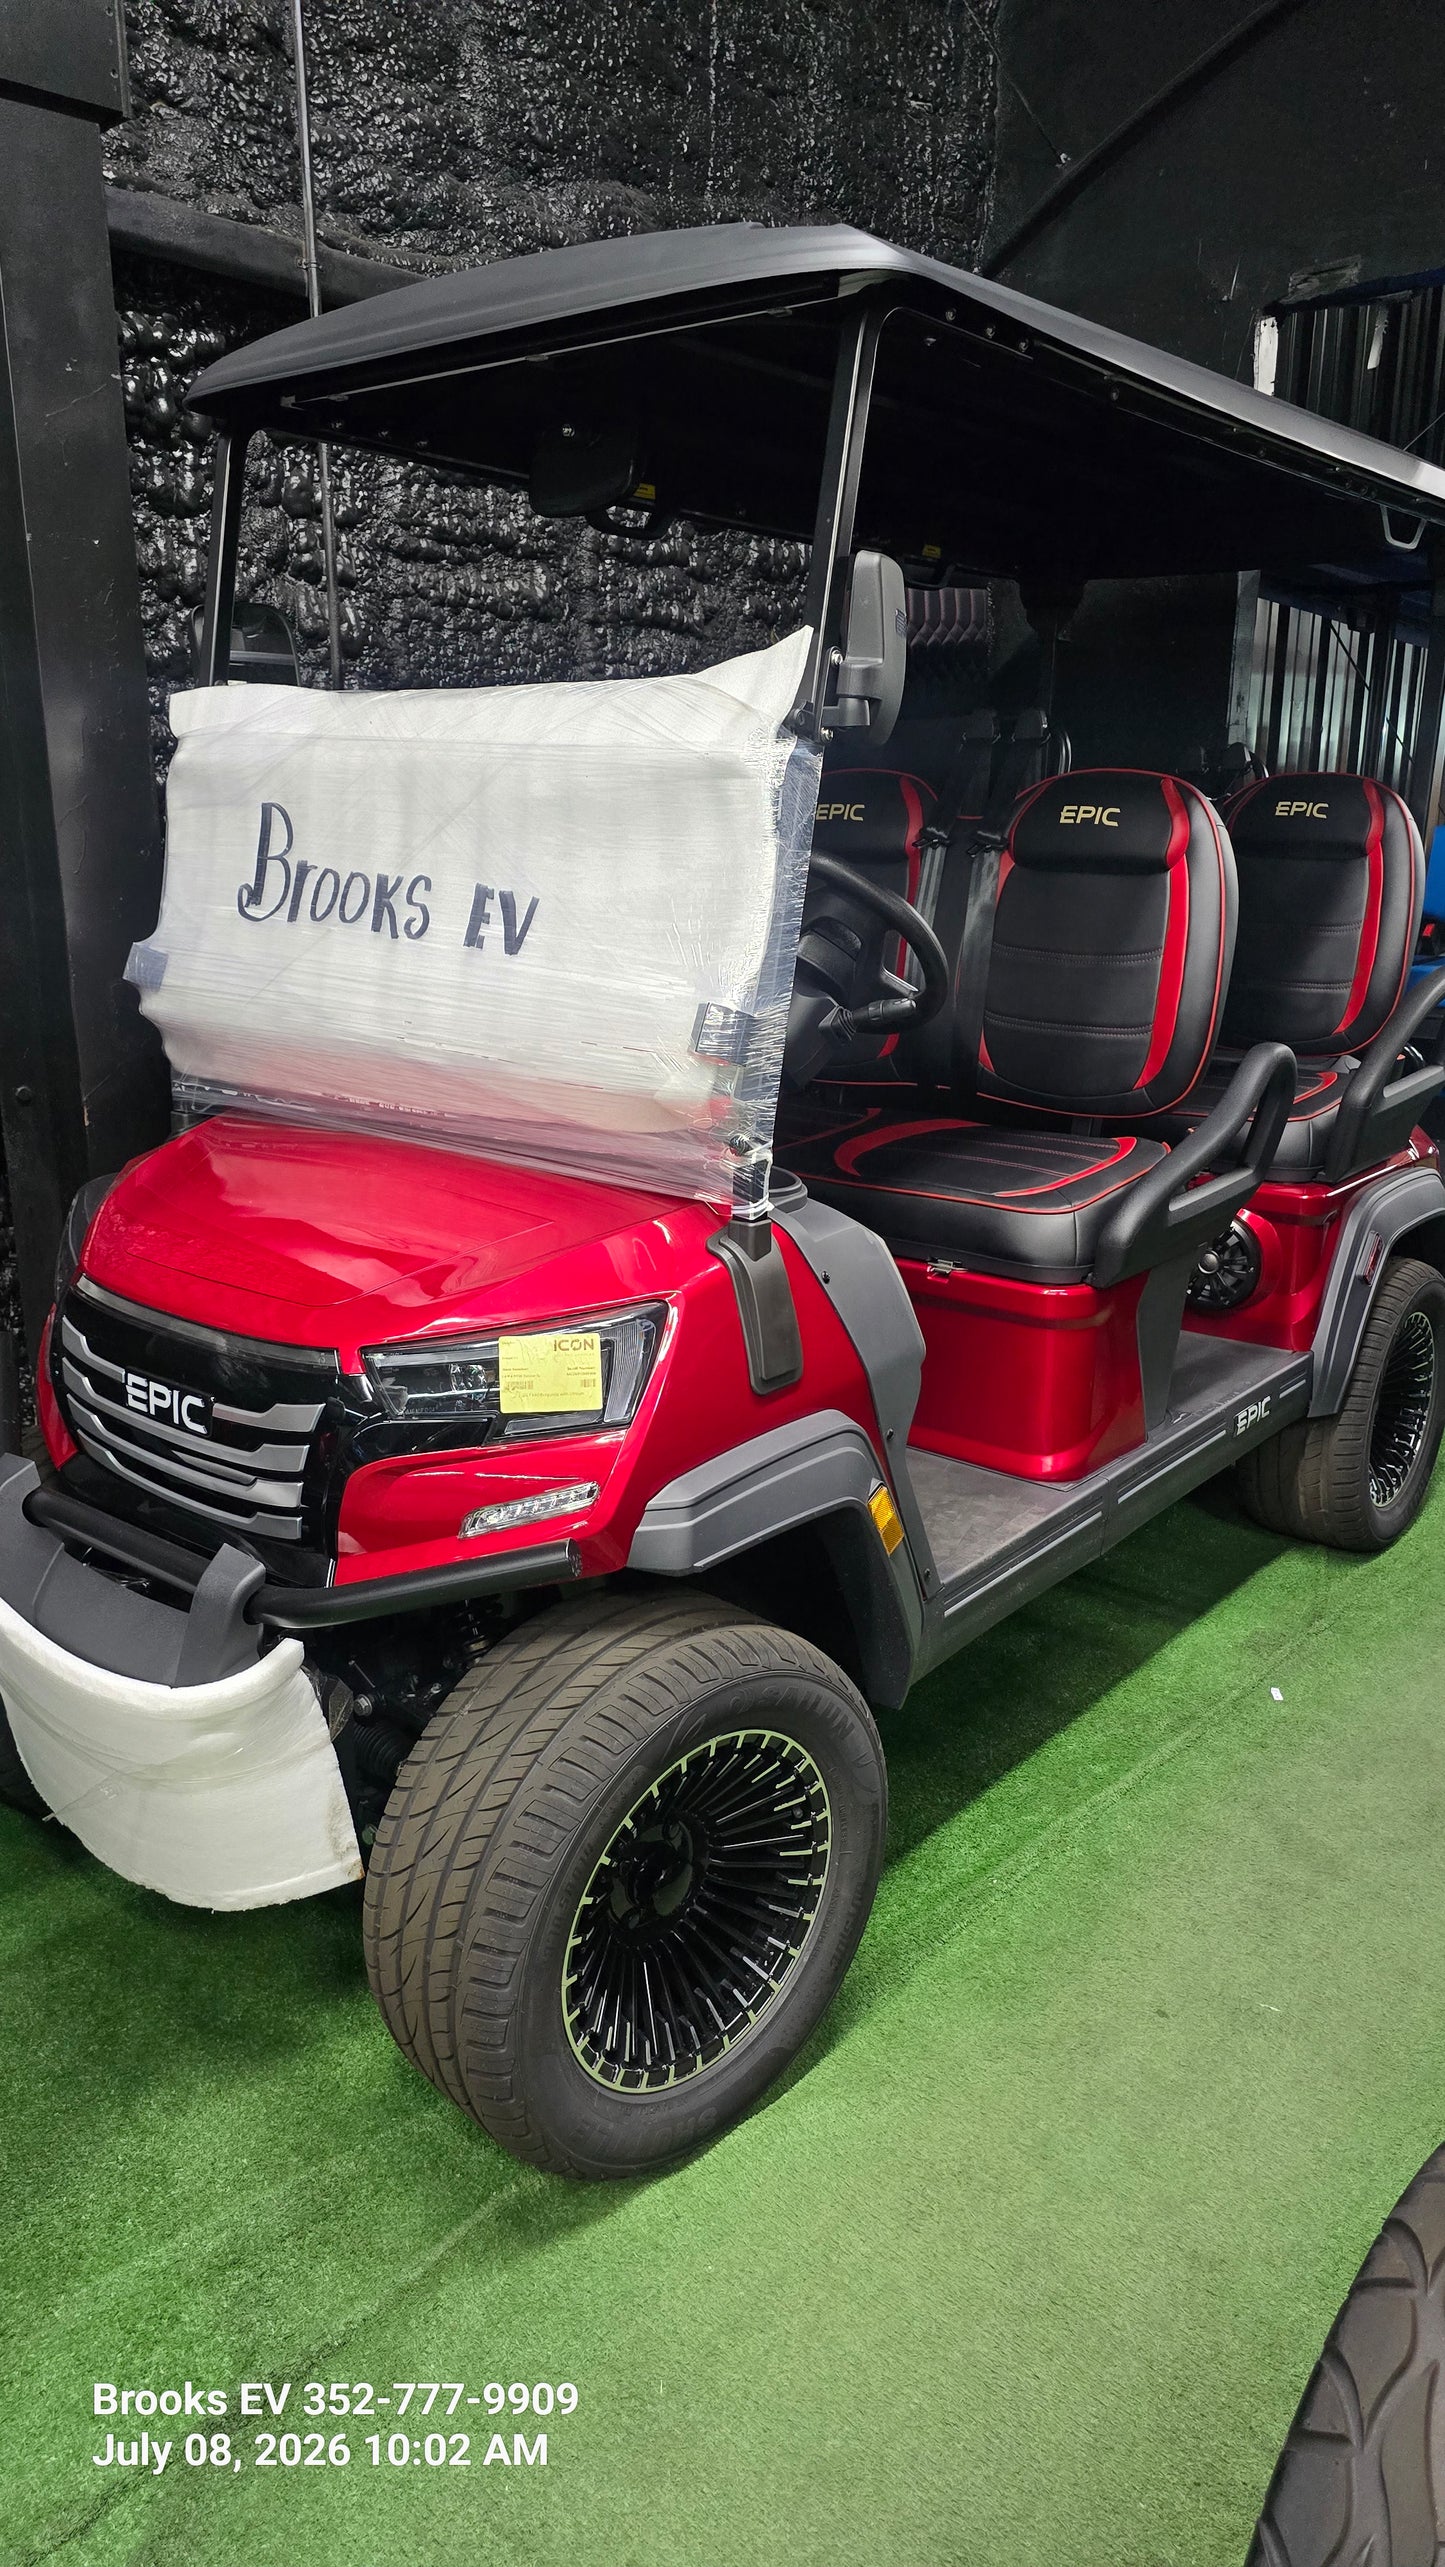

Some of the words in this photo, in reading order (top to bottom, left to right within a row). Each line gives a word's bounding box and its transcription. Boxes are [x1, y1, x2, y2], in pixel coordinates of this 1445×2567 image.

[816, 803, 865, 822] EPIC
[1059, 805, 1121, 827] EPIC
[1274, 801, 1329, 819] EPIC
[463, 882, 540, 956] EV
[553, 1338, 594, 1352] ICON
[125, 1372, 209, 1436] EPIC
[1236, 1395, 1271, 1436] EPIC
